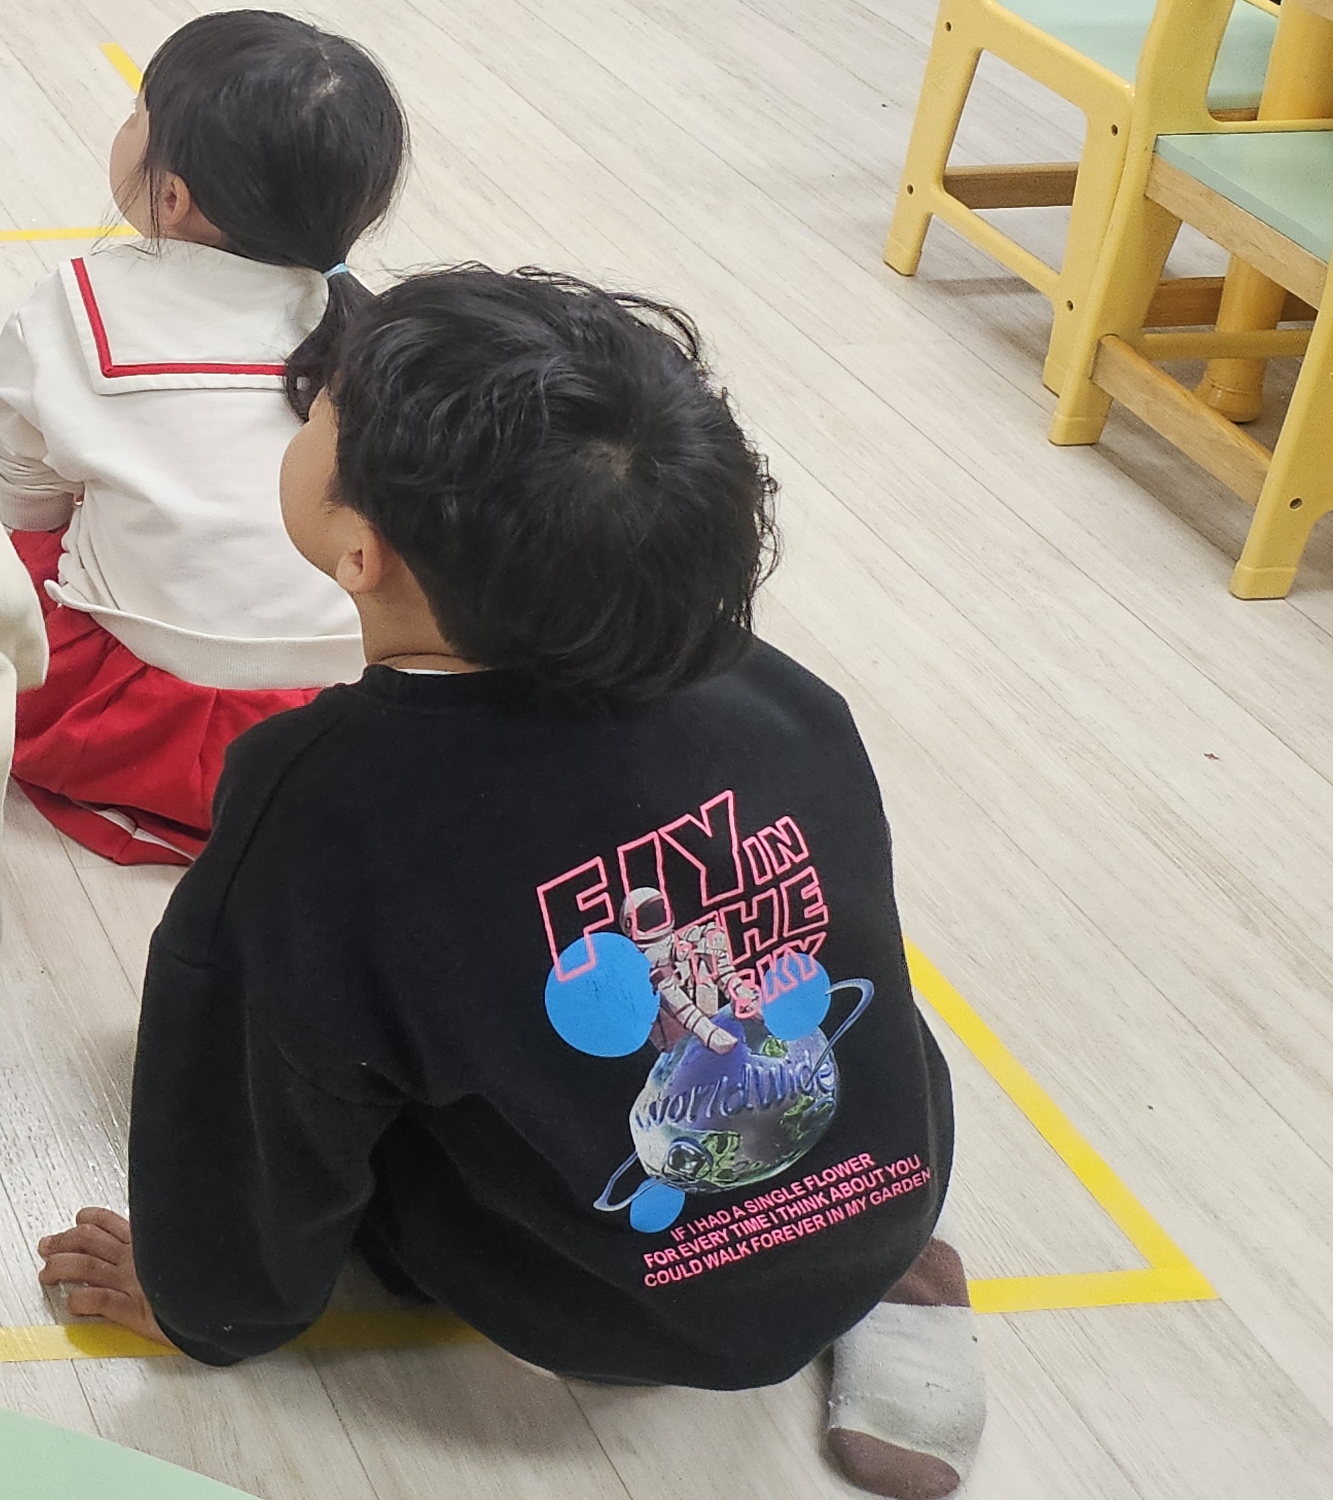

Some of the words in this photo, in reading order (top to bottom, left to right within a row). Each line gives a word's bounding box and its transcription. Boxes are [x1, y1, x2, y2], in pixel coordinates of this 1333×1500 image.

[741, 816, 810, 886] IN
[643, 1248, 680, 1269] FOR
[678, 1227, 731, 1258] EVERY
[731, 1214, 770, 1240] TIME
[778, 1191, 830, 1222] THINK
[828, 1171, 884, 1202] ABOUT
[883, 1154, 922, 1180] YOU
[643, 1258, 704, 1287] COULD
[703, 1241, 752, 1271] WALK
[751, 1212, 827, 1252] FOREVER
[827, 1206, 845, 1224] IN
[844, 1196, 869, 1217] MY
[869, 1166, 931, 1206] GARDEN
[670, 1226, 687, 1242] IF
[696, 1208, 731, 1233] HAD
[732, 1205, 746, 1220] A
[743, 1182, 807, 1215] SINGLE
[805, 1152, 876, 1192] FLOWER
